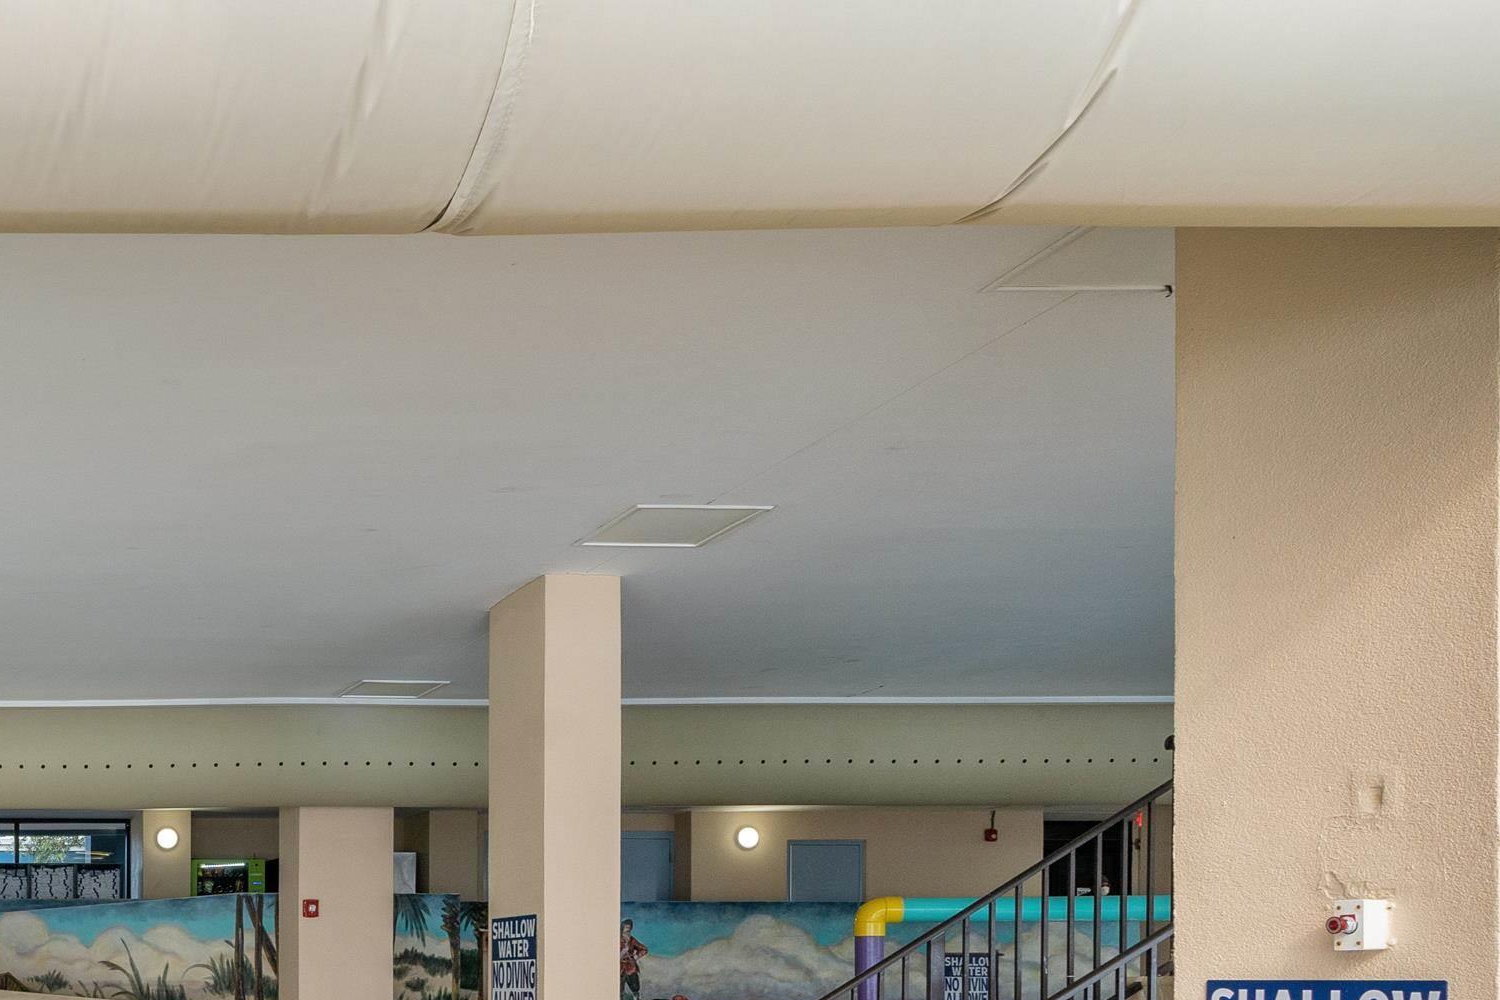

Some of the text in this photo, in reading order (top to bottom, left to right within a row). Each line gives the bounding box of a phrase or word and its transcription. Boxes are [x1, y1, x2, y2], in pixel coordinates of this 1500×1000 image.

[492, 918, 536, 940] SHALLOW
[498, 939, 529, 958] WATER
[493, 961, 535, 989] NO DIVING
[952, 967, 988, 976] WTER
[945, 978, 988, 991] NO IVIN
